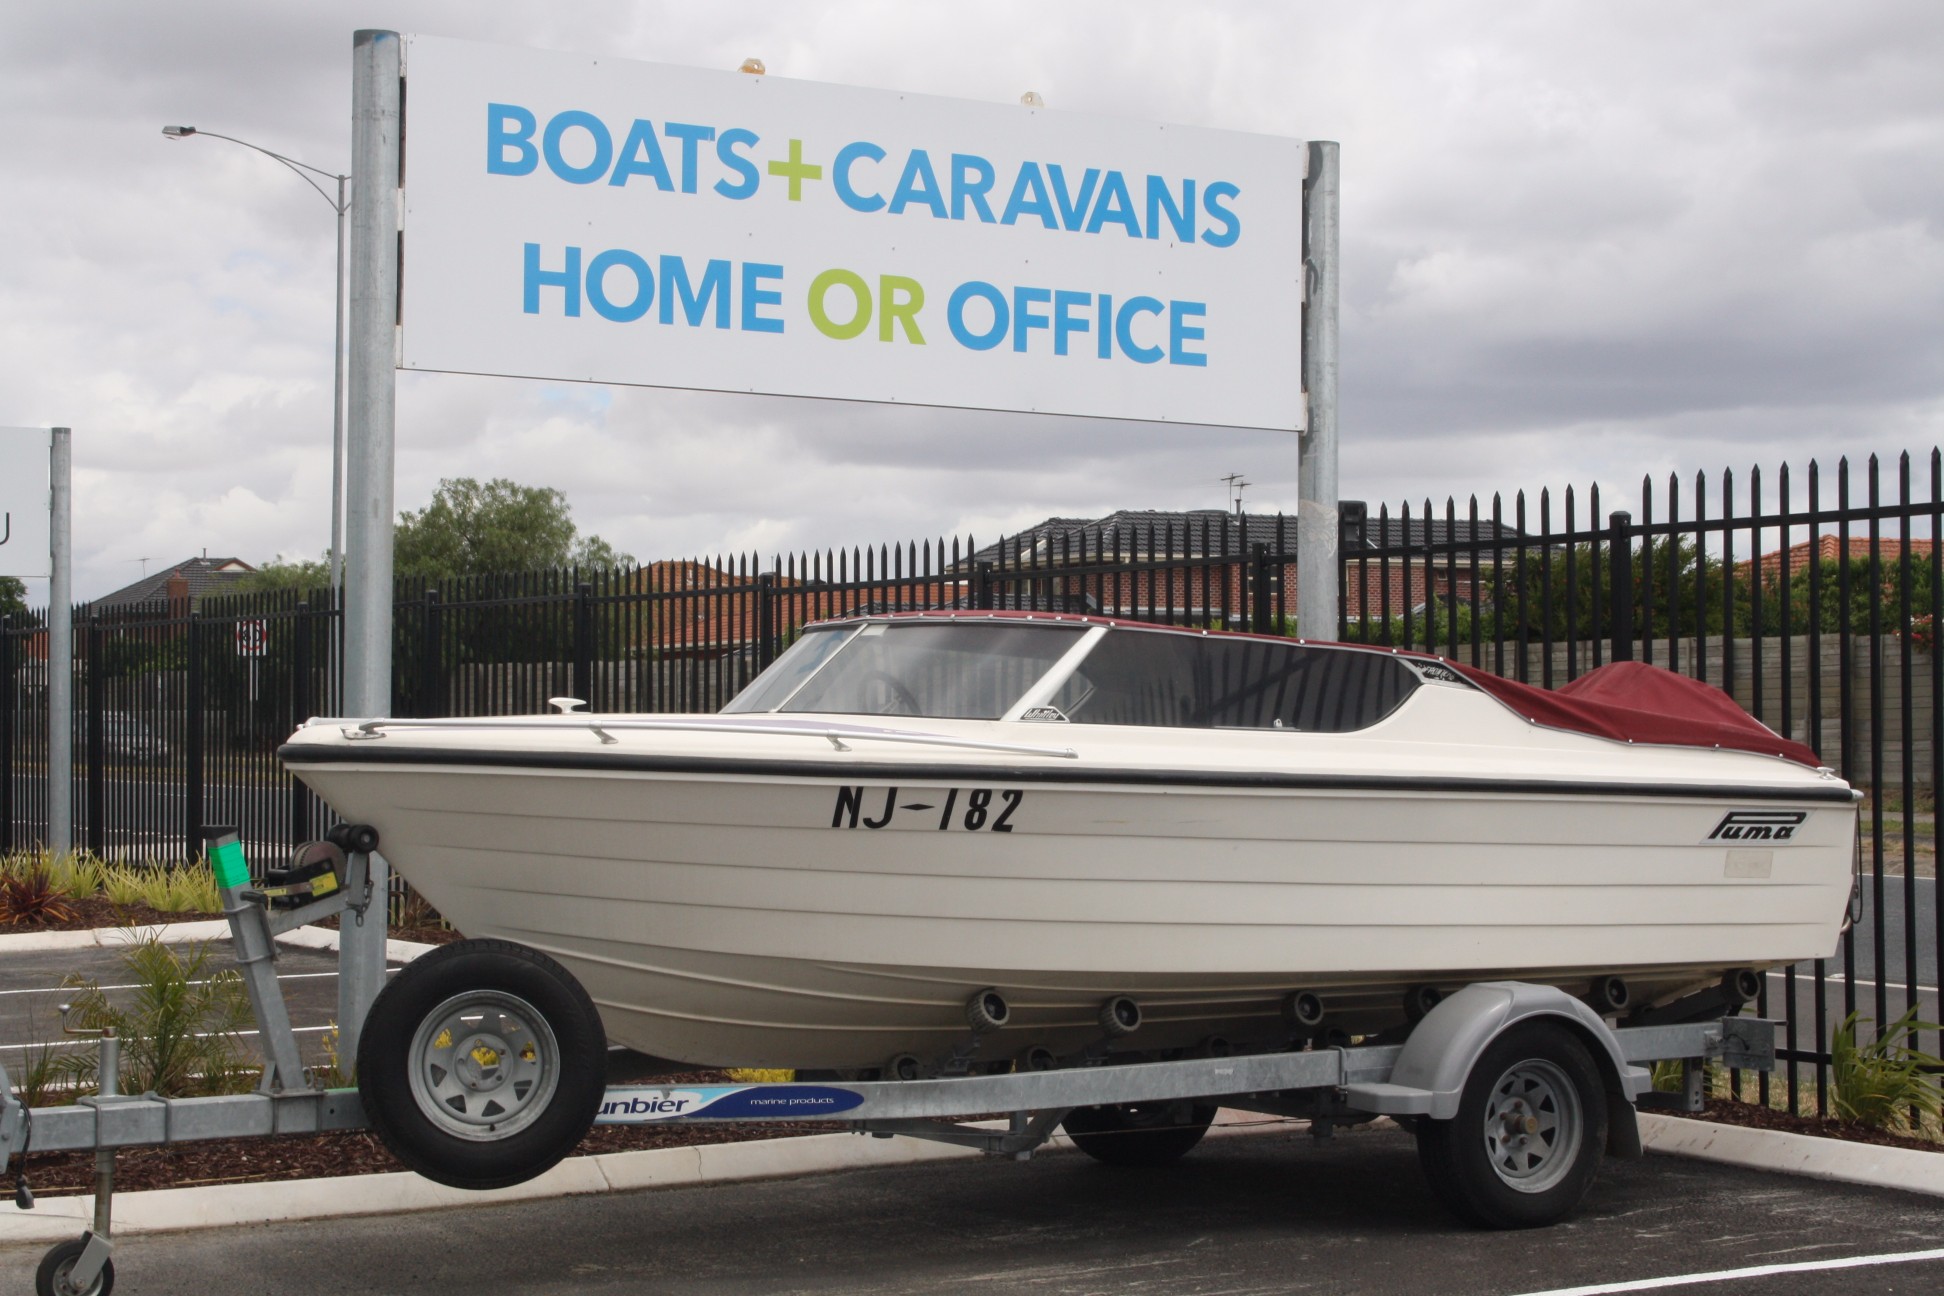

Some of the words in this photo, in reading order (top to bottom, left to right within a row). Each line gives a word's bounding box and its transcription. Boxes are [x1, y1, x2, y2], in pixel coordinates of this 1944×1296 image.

[523, 242, 785, 334] HOME
[807, 268, 927, 345] OR
[947, 281, 1208, 367] OFFICE
[1708, 811, 1807, 840] Puma
[750, 1097, 787, 1106] marine
[789, 1096, 835, 1107] products
